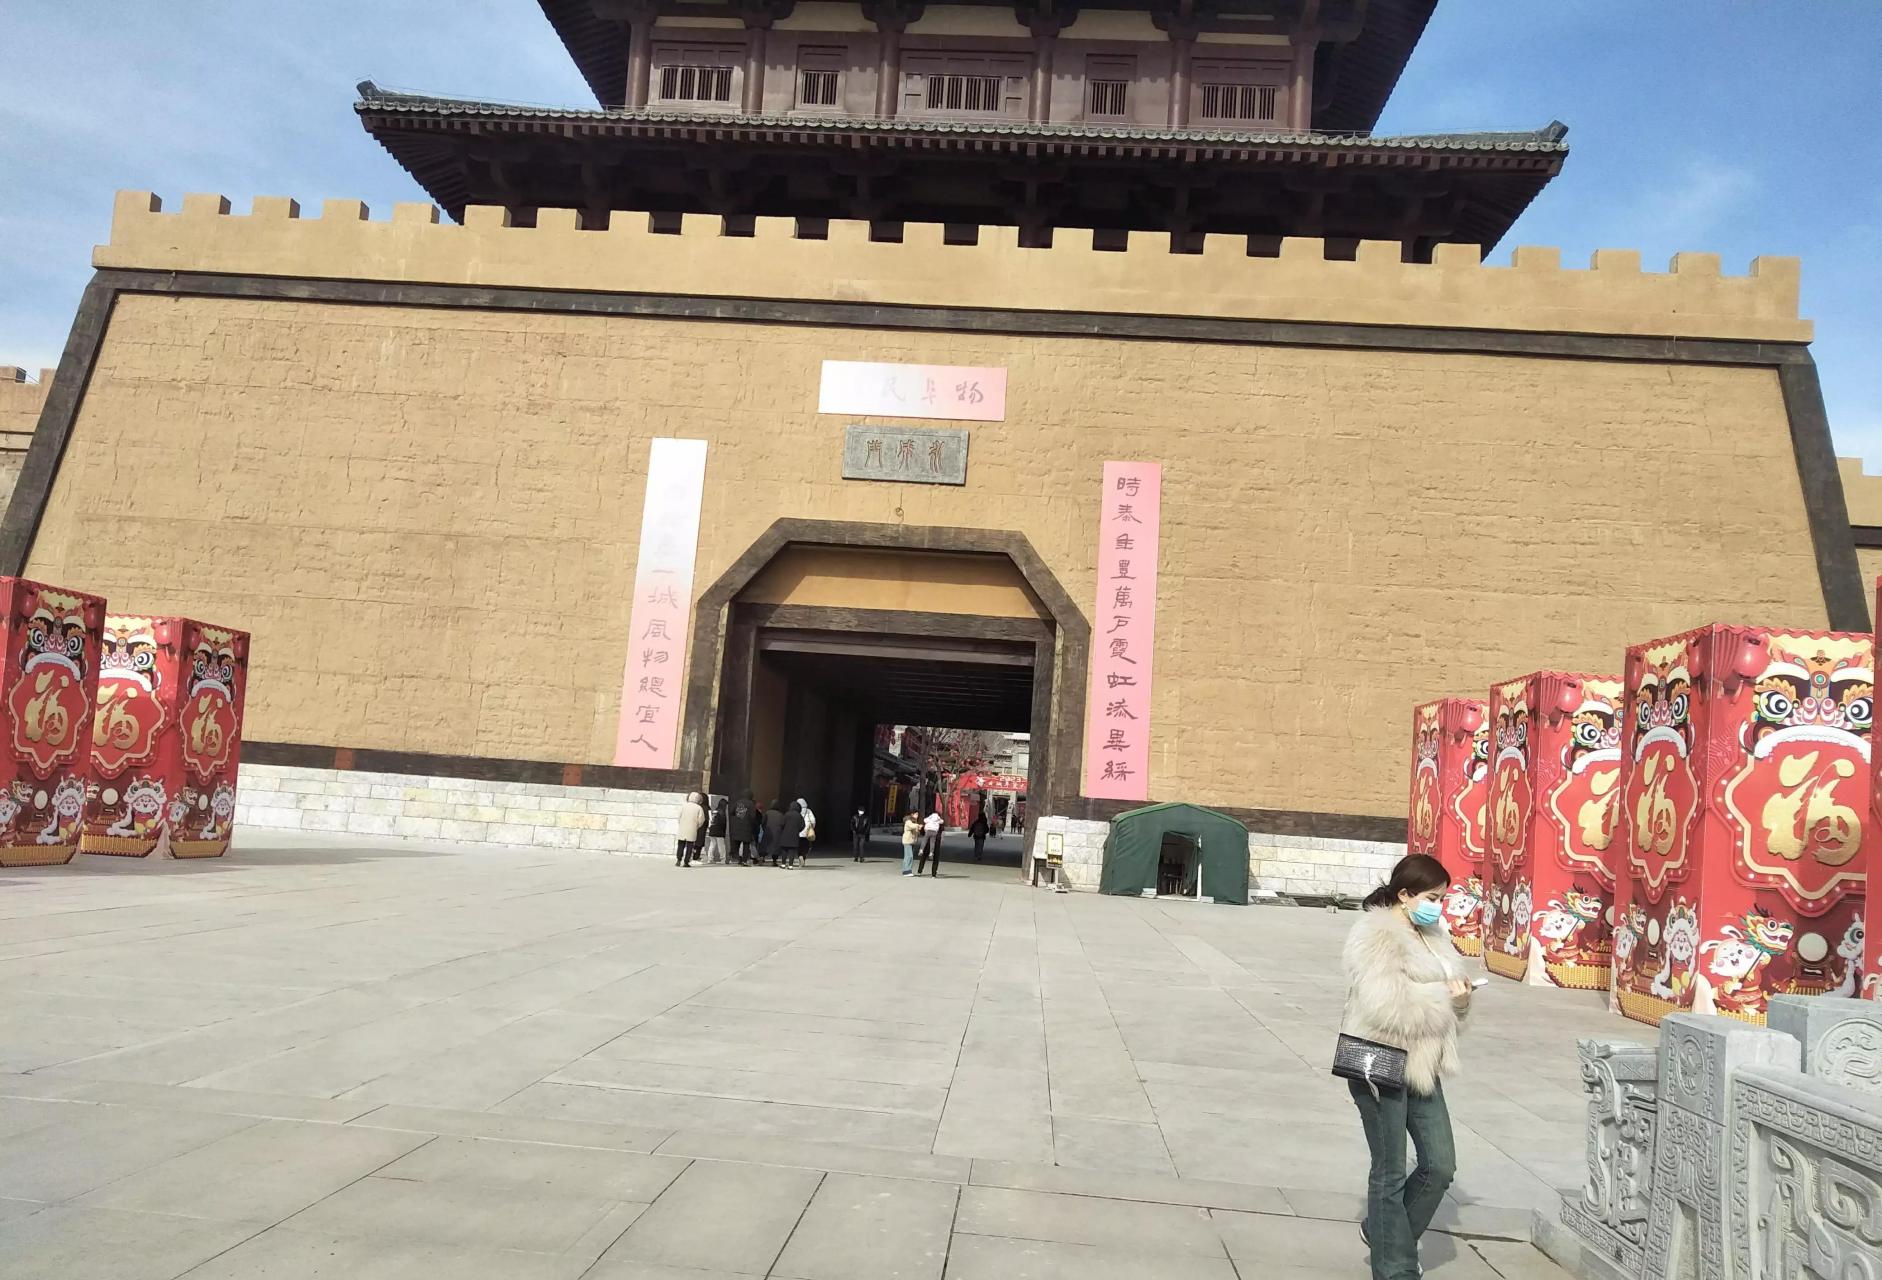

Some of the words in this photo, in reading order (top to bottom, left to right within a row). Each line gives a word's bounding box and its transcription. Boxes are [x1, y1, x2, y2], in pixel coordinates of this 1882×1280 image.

[24, 668, 69, 746] 福
[94, 682, 140, 750] 福
[190, 693, 223, 757] 福
[1415, 773, 1433, 840] 福
[1495, 763, 1520, 846] 福
[1636, 750, 1678, 857] 福
[1757, 750, 1863, 866] 福
